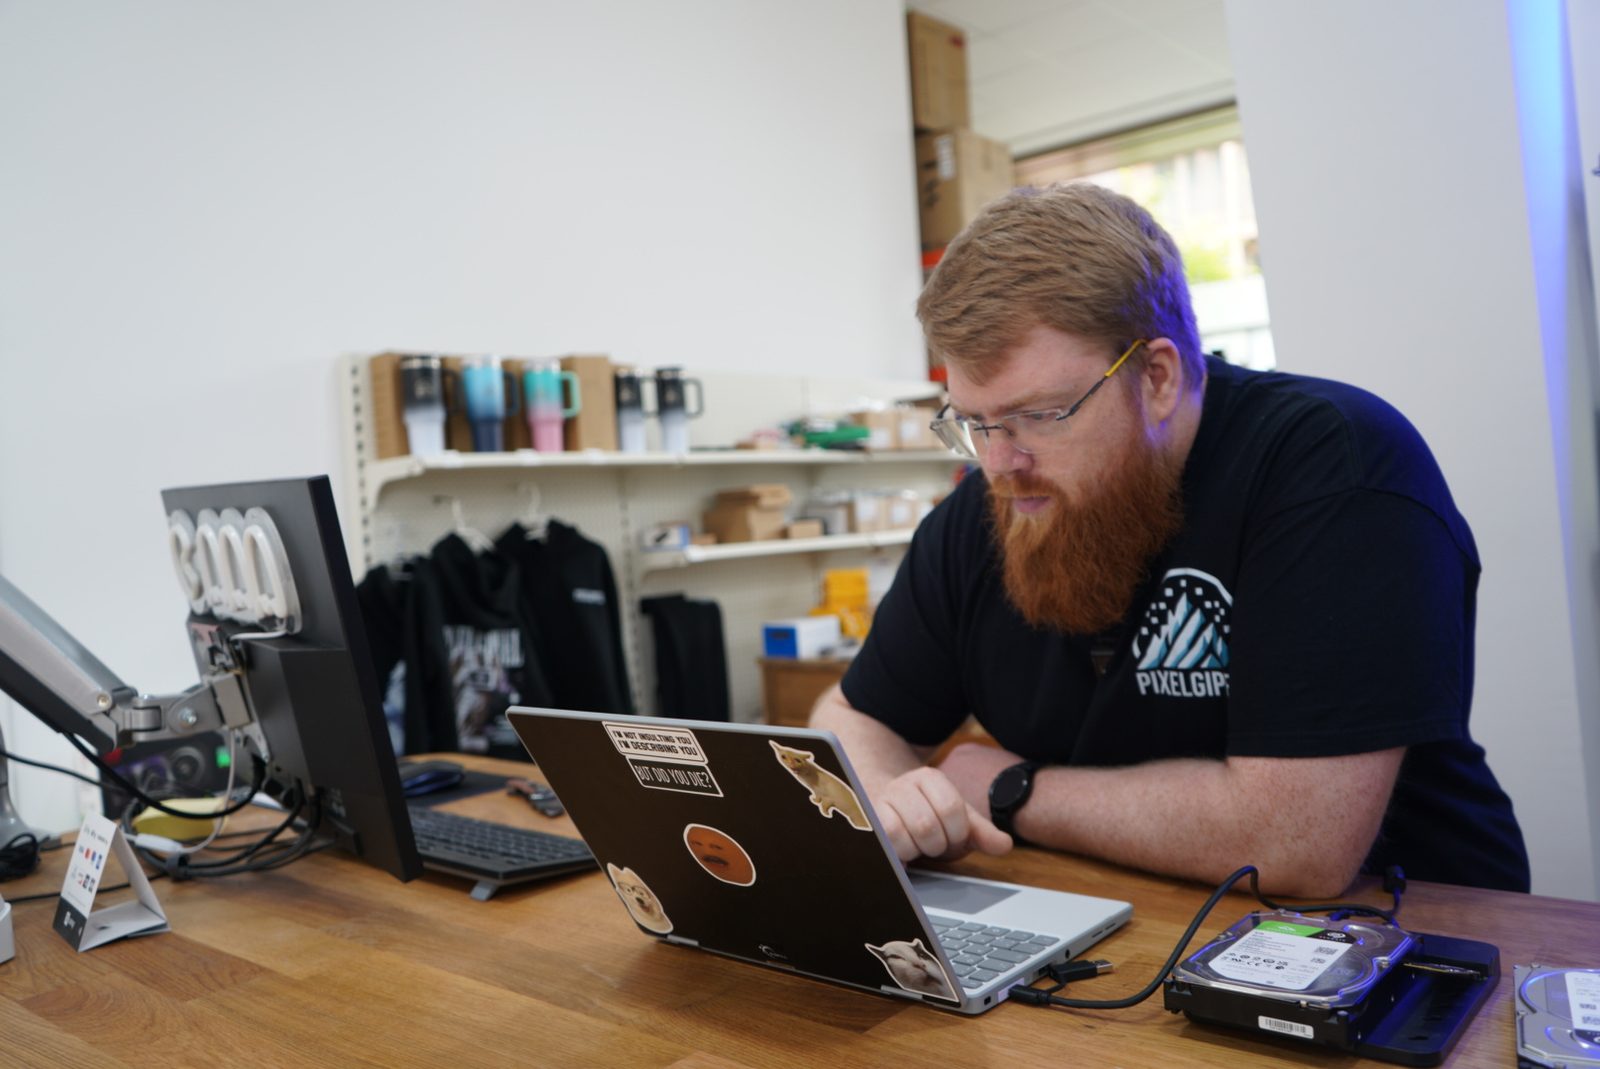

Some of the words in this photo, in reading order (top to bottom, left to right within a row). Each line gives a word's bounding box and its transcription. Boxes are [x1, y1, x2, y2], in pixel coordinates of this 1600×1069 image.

[622, 731, 638, 740] NOT
[640, 733, 676, 743] INSULTING
[675, 736, 692, 745] YOU
[631, 741, 679, 754] DESCRIBING
[678, 746, 698, 756] YOU
[635, 765, 655, 781] BUT
[652, 767, 671, 783] DID
[667, 769, 690, 786] YOU
[687, 771, 713, 788] DIE?
